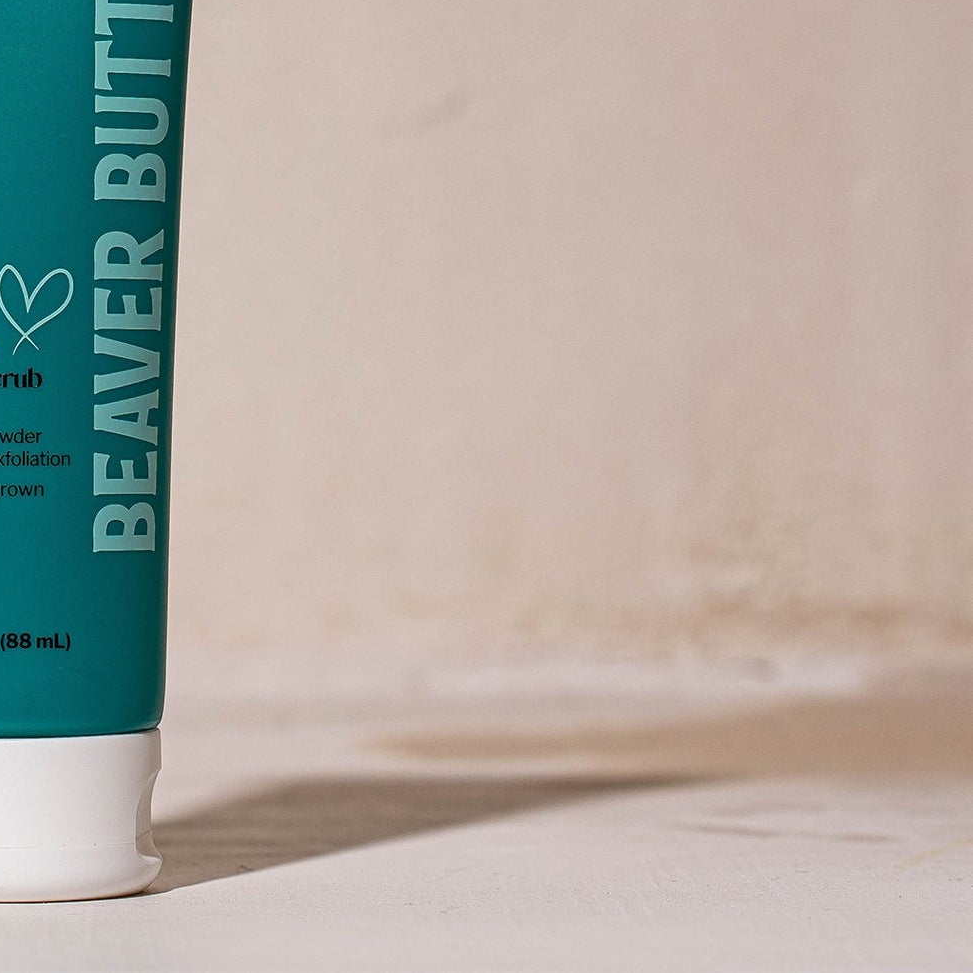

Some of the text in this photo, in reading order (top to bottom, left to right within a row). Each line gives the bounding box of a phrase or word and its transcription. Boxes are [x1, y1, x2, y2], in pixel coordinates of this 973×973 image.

[93, 229, 165, 553] BEAVER
[0, 632, 32, 652] (88
[36, 632, 71, 652] mL)
